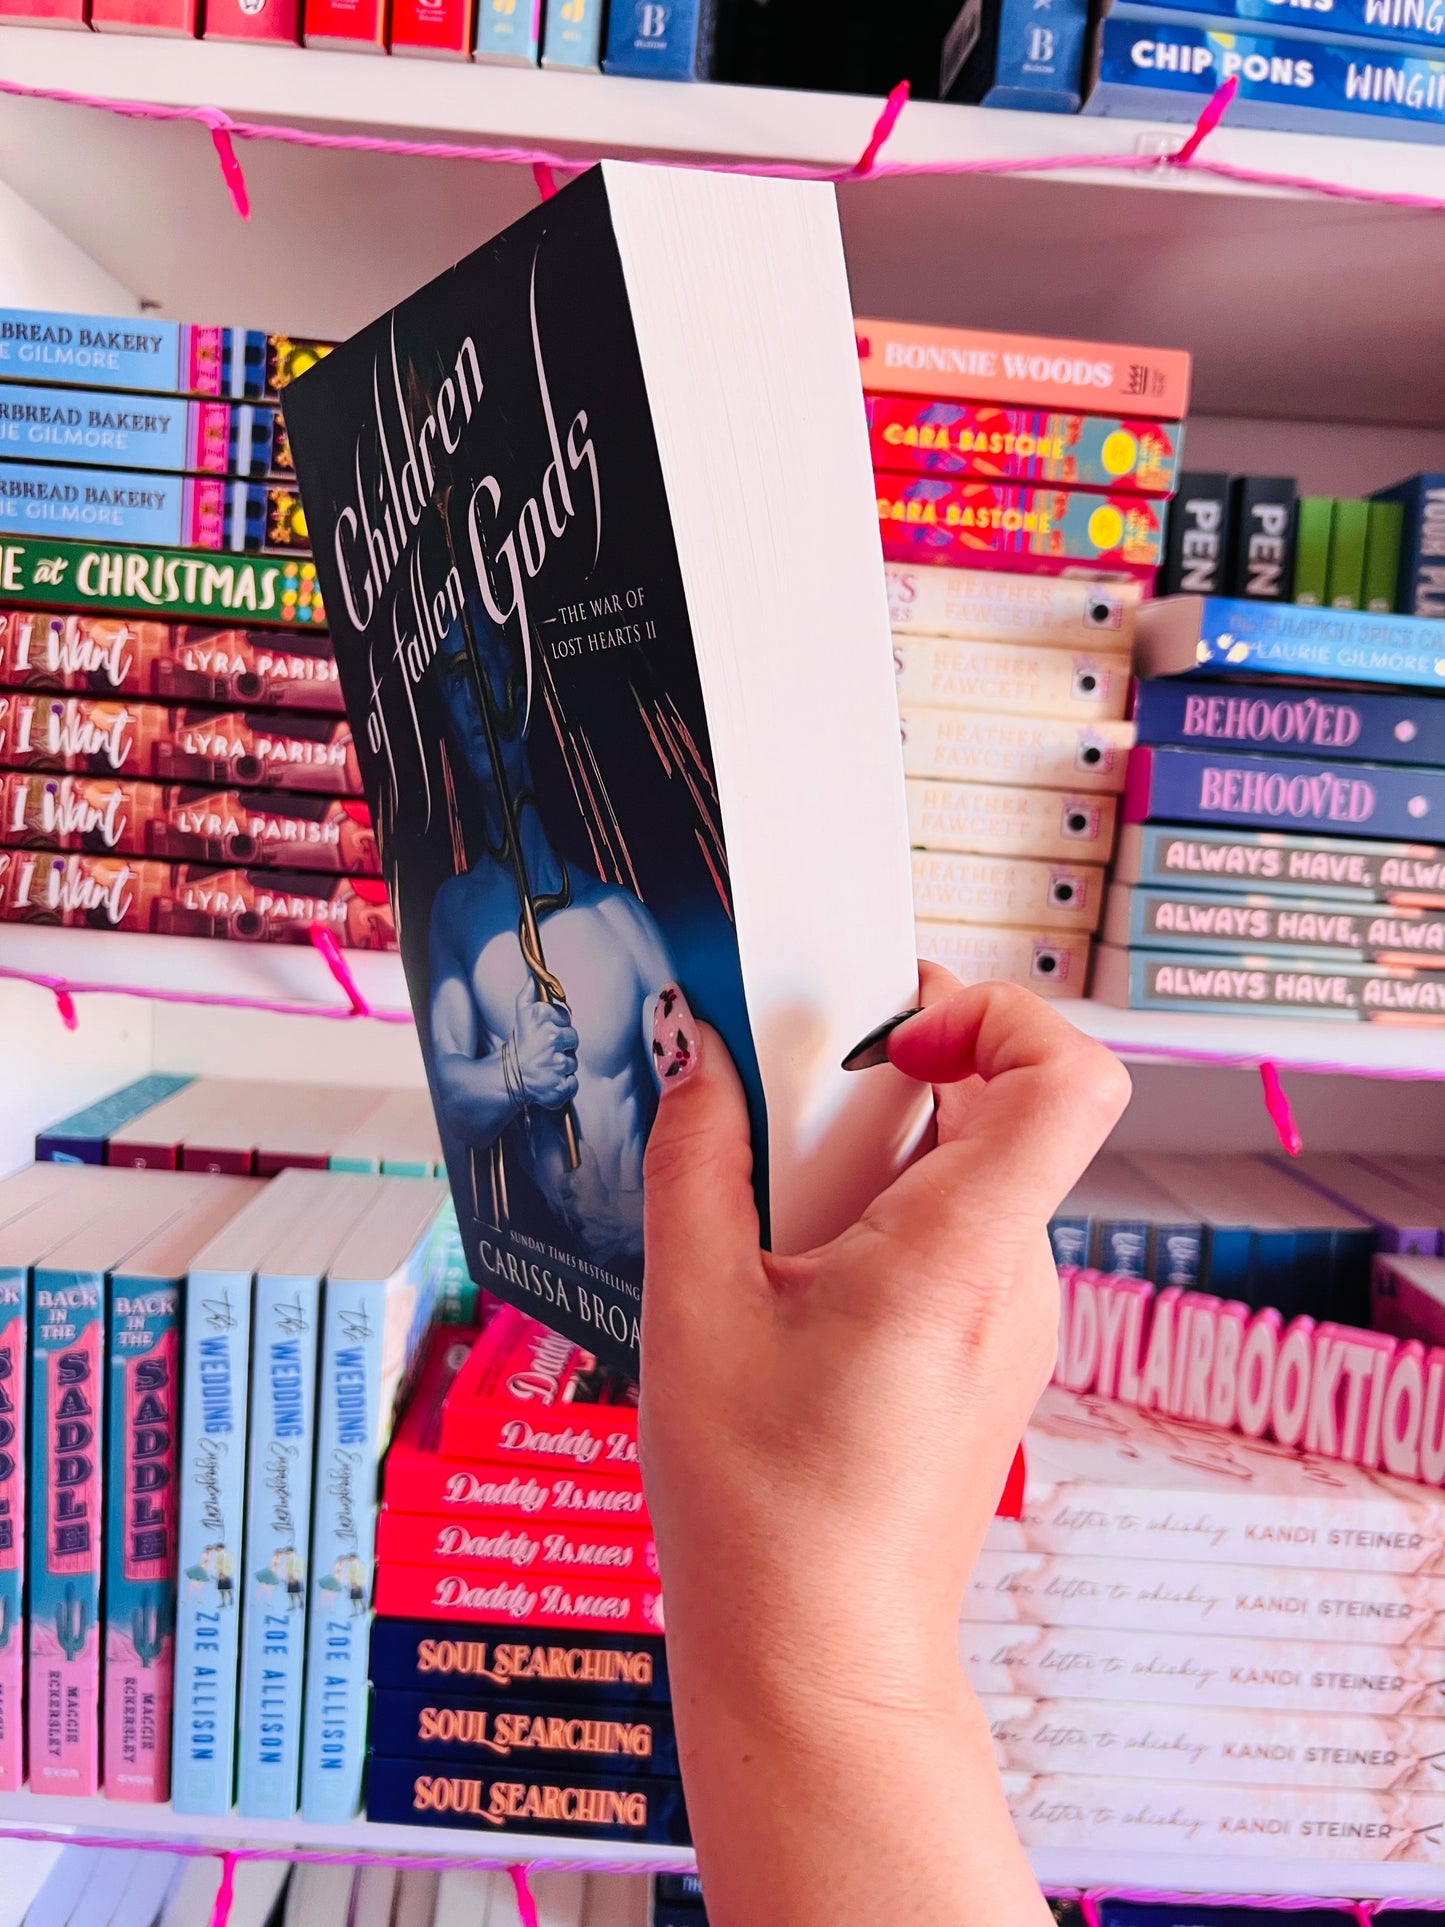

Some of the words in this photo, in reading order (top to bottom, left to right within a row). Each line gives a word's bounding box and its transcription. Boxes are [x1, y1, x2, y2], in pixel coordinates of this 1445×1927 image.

[1131, 40, 1214, 75] CHIP
[1222, 51, 1314, 88] PONS
[18, 343, 120, 370] GILMORE
[79, 328, 163, 353] BAKERY
[884, 343, 996, 377] BONNIE
[1003, 353, 1114, 388] WOODS
[28, 425, 129, 450] GILMORE
[88, 410, 172, 434] BAKERY
[883, 423, 949, 449] CARA
[959, 431, 1064, 460] BASTONE
[333, 310, 485, 633] Children
[467, 242, 602, 742] Gods
[26, 502, 125, 527] GILMORE
[85, 487, 168, 511] BAKERY
[877, 498, 937, 524] CARA
[946, 506, 1050, 534] BASTONE
[1181, 500, 1222, 591] PEN
[1246, 503, 1288, 596] PEN
[33, 556, 69, 585] at
[76, 551, 280, 611] CHRISTMAS
[589, 594, 623, 617] WAR
[626, 587, 645, 609] OF
[15, 624, 34, 670] I
[49, 616, 137, 687] Want
[551, 637, 582, 660] LOST
[588, 624, 641, 652] HEARTS
[646, 620, 657, 640] II
[1264, 617, 1350, 641] PUMPKIN
[1360, 624, 1413, 645] SPICE
[184, 651, 247, 675] LYRA
[1255, 640, 1331, 664] LAURIE
[1337, 649, 1429, 674] GILMORE
[15, 708, 34, 754] I
[50, 698, 137, 769] Want
[362, 641, 399, 816] of
[937, 720, 1044, 749] HEATHER
[1182, 694, 1361, 748] BEHOOVED
[184, 733, 247, 758] LYRA
[256, 739, 347, 766] PARISH
[9, 785, 28, 833] I
[42, 776, 130, 847] Want
[922, 788, 1031, 816] HEATHER
[1199, 767, 1376, 823] BEHOOVED
[177, 812, 240, 837] LYRA
[251, 817, 340, 845] PARISH
[1166, 841, 1284, 877] ALWAYS
[1288, 852, 1374, 888] HAVE,
[14, 862, 34, 909] I
[50, 855, 137, 924] Want
[184, 889, 248, 913] LYRA
[257, 894, 348, 923] PARISH
[1155, 902, 1269, 938] ALWAYS
[1278, 913, 1360, 946] HAVE,
[1155, 966, 1267, 1000] ALWAYS
[1276, 975, 1355, 1008] HAVE,
[479, 1240, 572, 1312] CARISSA
[509, 1230, 545, 1254] SUNDAY
[549, 1246, 576, 1268] TIMES
[578, 1259, 641, 1301] BESTSELLING
[38, 1290, 98, 1309] BACK
[48, 1308, 68, 1325] IN
[115, 1296, 176, 1317] BACK
[40, 1324, 76, 1340] THE
[117, 1330, 154, 1346] THE
[127, 1314, 146, 1331] IN
[199, 1335, 233, 1436] WEDDING
[271, 1339, 305, 1441] WEDDING
[335, 1345, 366, 1446] WEDDING
[53, 1349, 94, 1556] SADDLE
[131, 1357, 168, 1563] SADDLE
[497, 1419, 603, 1464] Daddy
[196, 1437, 230, 1540] Engagement
[269, 1441, 300, 1543] Engagement
[336, 1447, 364, 1549] Engagement
[443, 1471, 551, 1514] Daddy
[552, 1480, 643, 1513] Issues
[435, 1525, 540, 1567] Daddy
[543, 1533, 634, 1568] Issues
[1244, 1524, 1316, 1544] KANDI
[1327, 1530, 1424, 1550] STEINER
[432, 1576, 537, 1618] Daddy
[538, 1584, 630, 1619] Issues
[1235, 1594, 1308, 1615] KANDI
[1318, 1599, 1414, 1620] STEINER
[194, 1612, 220, 1653] ZOE
[264, 1616, 290, 1656] ZOE
[325, 1622, 352, 1662] ZOE
[417, 1640, 511, 1685] SOUL
[494, 1644, 653, 1687] SEARCHING
[1229, 1667, 1302, 1687] KANDI
[1311, 1671, 1406, 1692] STEINER
[191, 1667, 219, 1760] ALLISON
[259, 1671, 286, 1764] ALLISON
[320, 1676, 350, 1771] ALLISON
[418, 1708, 510, 1755] SOUL
[493, 1712, 653, 1758] SEARCHING
[1222, 1742, 1295, 1762] KANDI
[1305, 1746, 1399, 1767] STEINER
[414, 1776, 504, 1825] SOUL
[489, 1780, 648, 1828] SEARCHING
[1218, 1815, 1290, 1836] KANDI
[1301, 1820, 1393, 1840] STEINER
